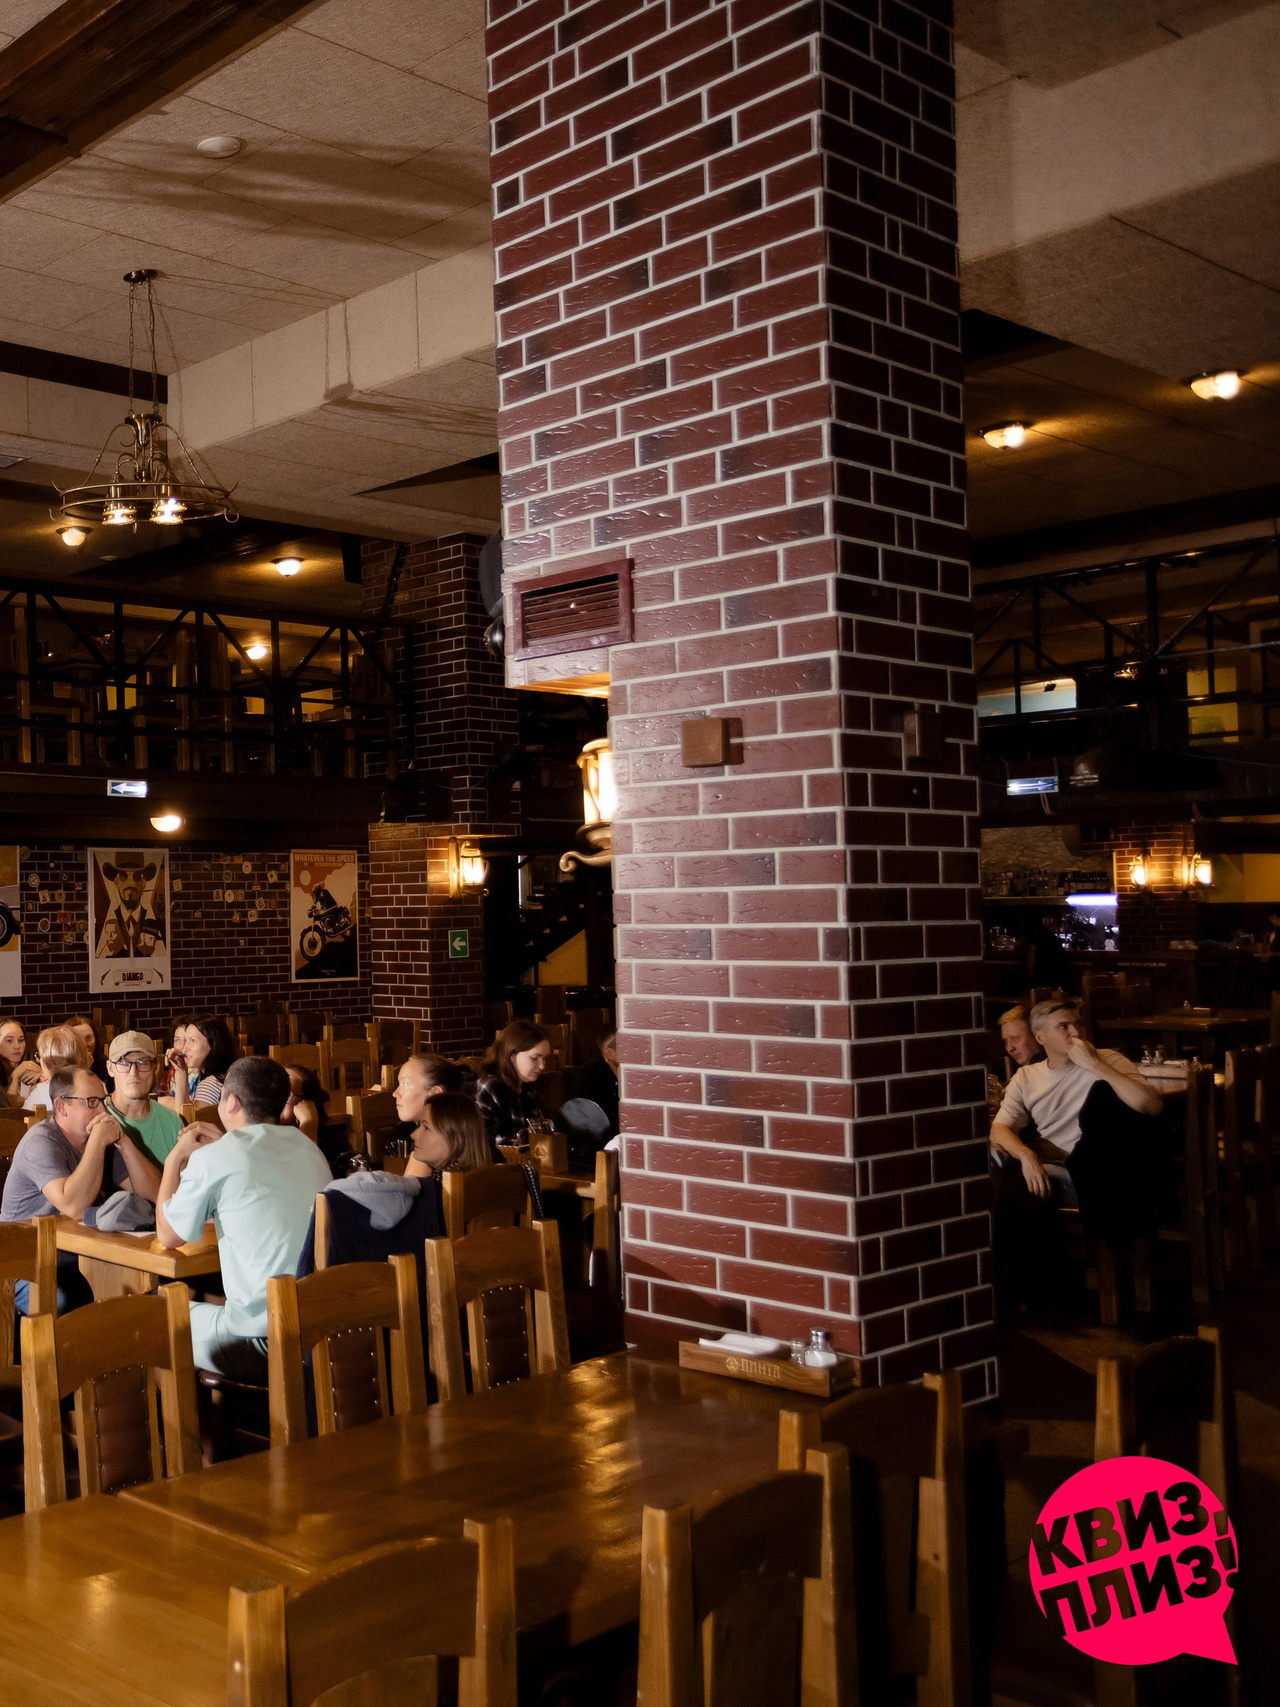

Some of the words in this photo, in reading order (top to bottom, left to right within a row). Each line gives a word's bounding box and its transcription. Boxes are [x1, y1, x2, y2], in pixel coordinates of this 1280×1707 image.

[326, 854, 336, 862] THE
[337, 854, 354, 862] SPEED
[122, 972, 143, 981] DJANGO
[740, 1358, 782, 1380] ПИНТА
